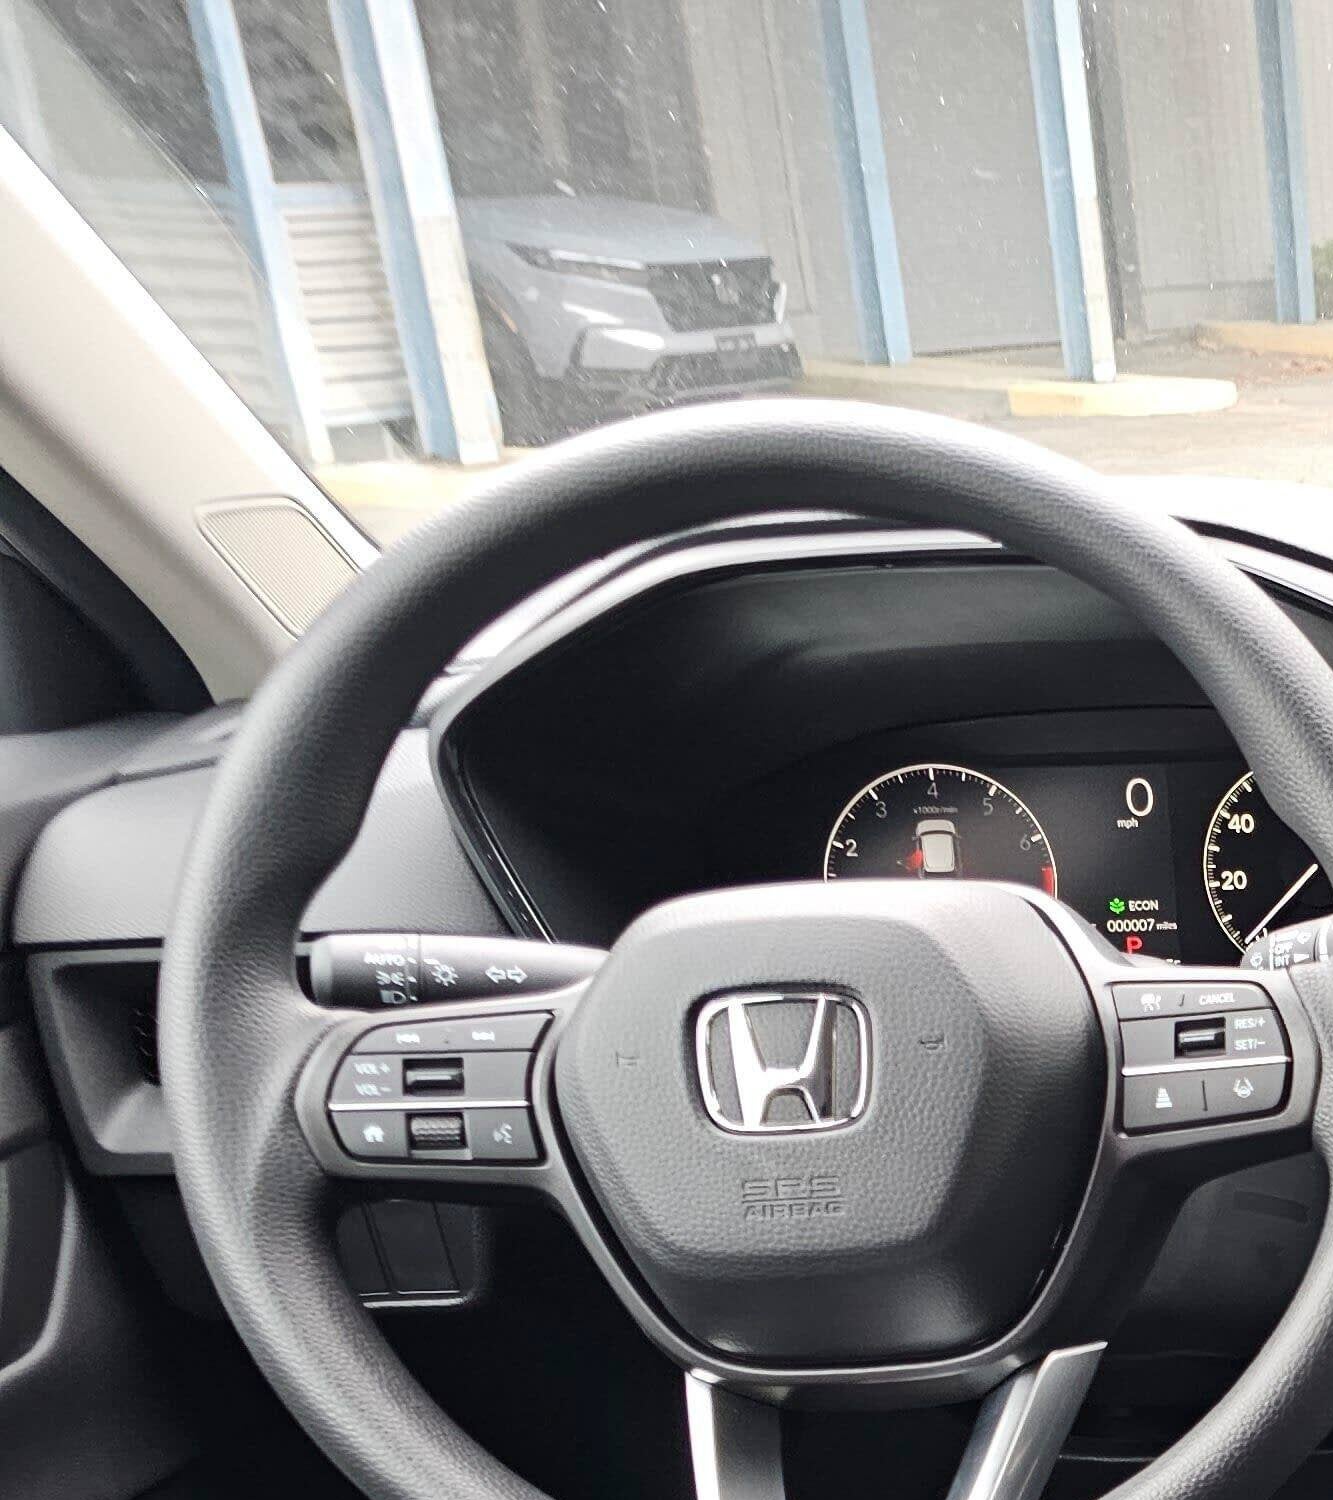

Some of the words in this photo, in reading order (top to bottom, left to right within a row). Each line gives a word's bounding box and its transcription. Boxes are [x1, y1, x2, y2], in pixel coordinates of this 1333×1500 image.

[927, 782, 939, 798] 4
[1126, 778, 1154, 817] 0
[875, 801, 887, 818] 3
[982, 798, 994, 816] 5
[1117, 817, 1139, 829] mph
[1228, 813, 1255, 834] 40
[846, 839, 858, 857] 2
[1020, 835, 1031, 850] 6
[1221, 870, 1248, 891] 20
[1128, 900, 1159, 911] ECON
[1107, 919, 1155, 932] 000007
[1156, 921, 1178, 930] miles
[1126, 936, 1143, 956] P
[1199, 993, 1235, 1005] CANCEL
